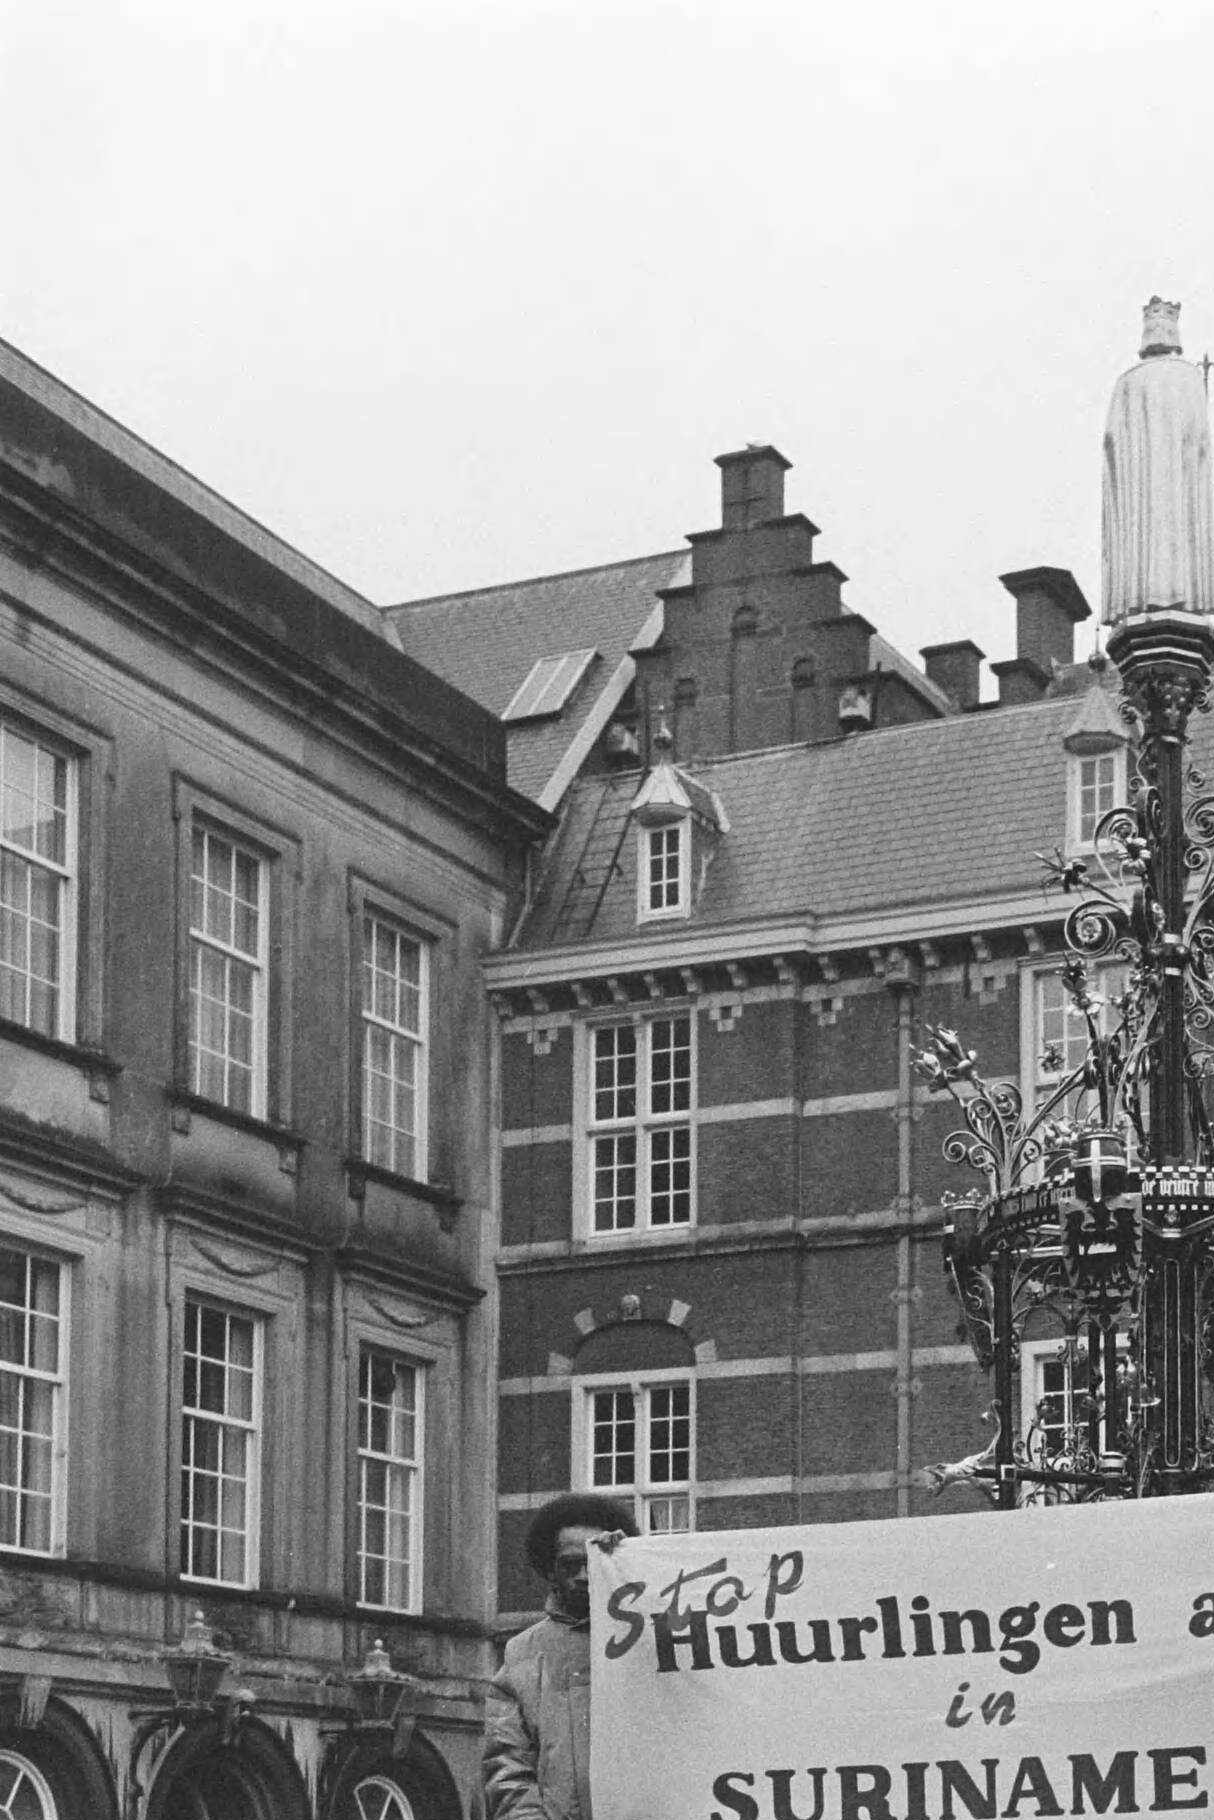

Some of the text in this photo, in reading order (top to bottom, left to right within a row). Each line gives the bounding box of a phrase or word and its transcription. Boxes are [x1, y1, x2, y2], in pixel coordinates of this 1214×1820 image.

[604, 1550, 804, 1660] Stop
[650, 1595, 1137, 1674] Huurlingen
[945, 1681, 1016, 1728] in
